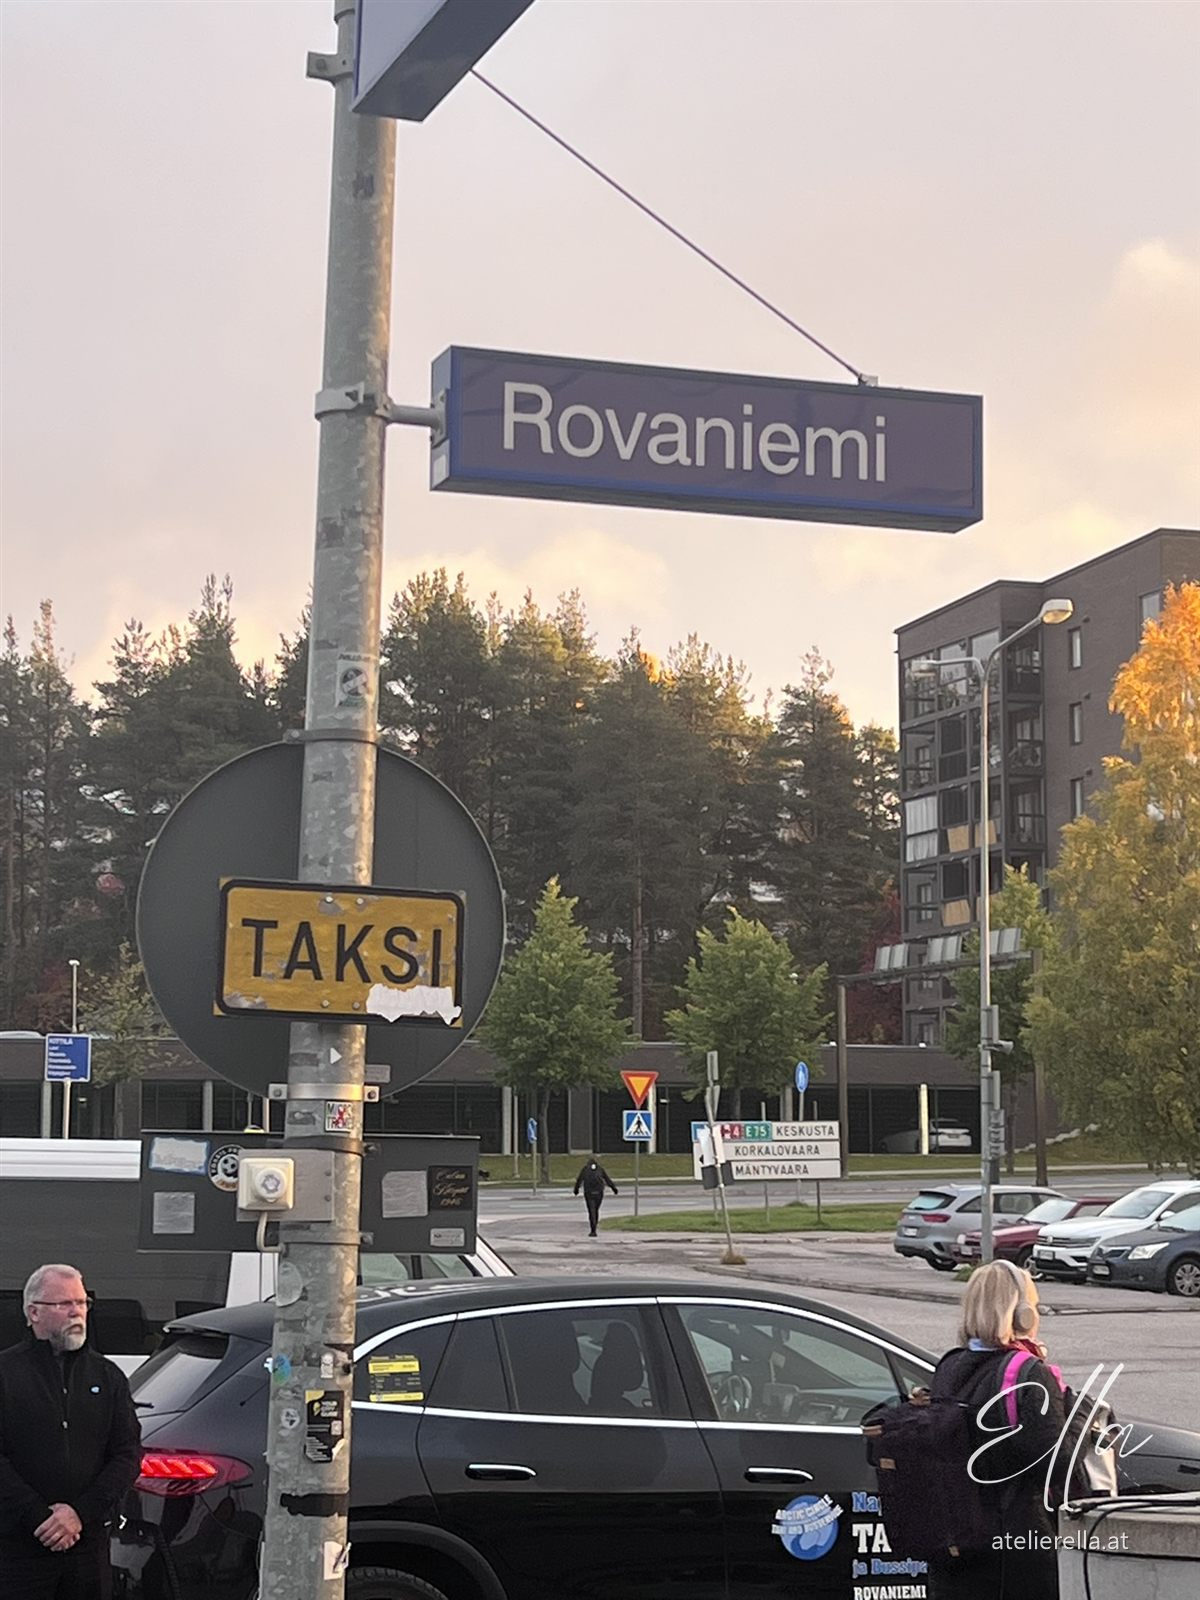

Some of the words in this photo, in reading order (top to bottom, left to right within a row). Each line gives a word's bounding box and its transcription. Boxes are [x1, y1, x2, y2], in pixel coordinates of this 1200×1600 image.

[503, 381, 887, 482] Rovaniemi
[241, 917, 442, 987] TAKSI
[776, 1125, 835, 1137] KESKUSTA
[734, 1144, 821, 1157] KORKALOVAARA
[735, 1164, 809, 1176] MÄNTYVAARA
[852, 1491, 882, 1516] Na
[852, 1559, 868, 1579] ja
[853, 1585, 927, 1600] ROVANIEMI
